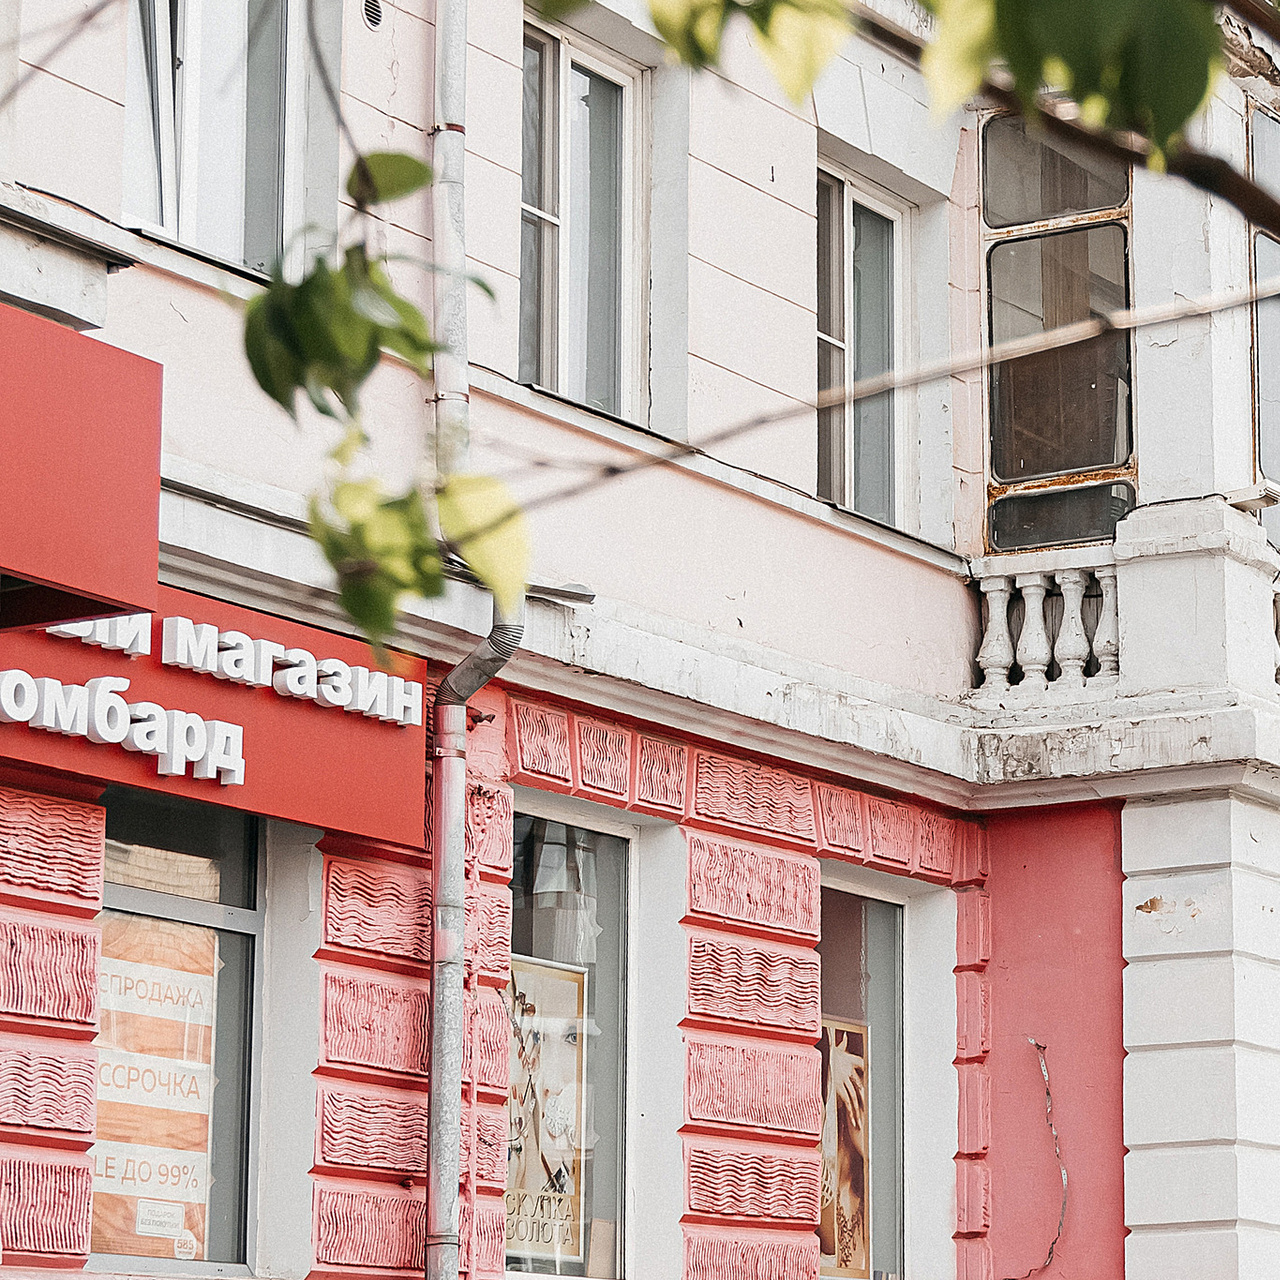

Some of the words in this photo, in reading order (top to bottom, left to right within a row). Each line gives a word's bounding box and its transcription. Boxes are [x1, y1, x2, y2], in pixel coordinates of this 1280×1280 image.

[162, 616, 422, 726] магазин
[99, 1062, 201, 1100] ССРОЧКА
[121, 1158, 152, 1186] ДО
[158, 1164, 199, 1189] 99%
[506, 1193, 575, 1222] СКУПКА
[506, 1218, 574, 1246] ЗОЛОТА
